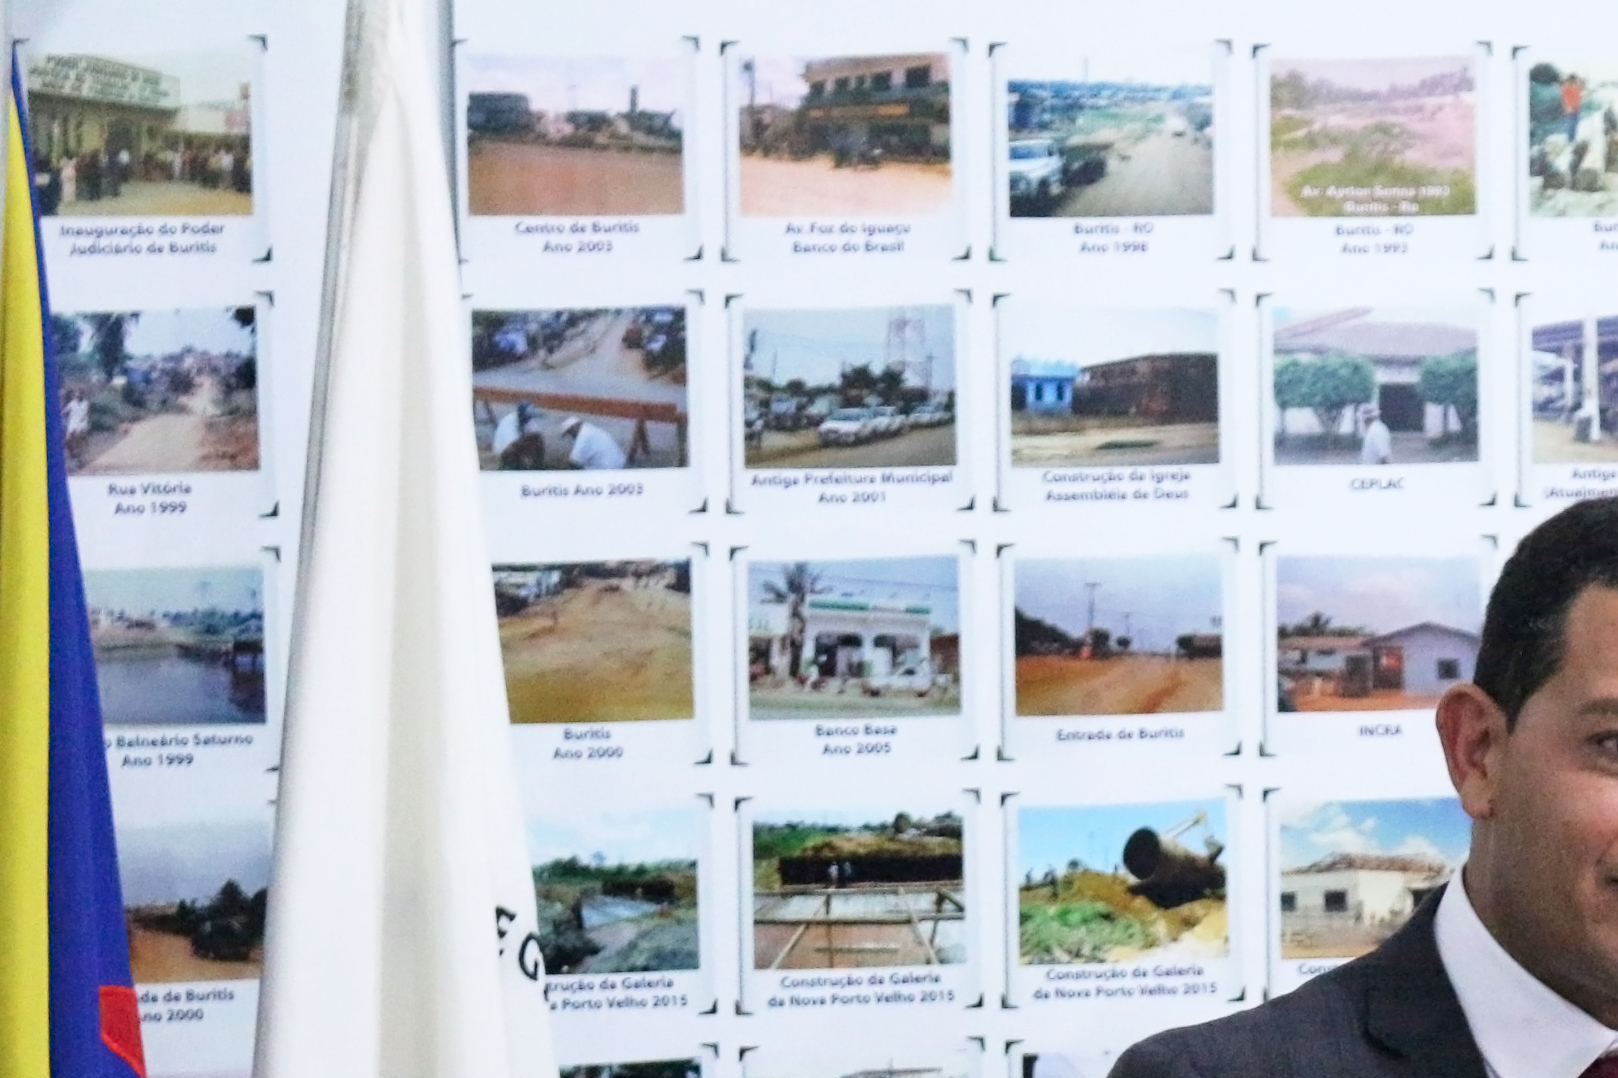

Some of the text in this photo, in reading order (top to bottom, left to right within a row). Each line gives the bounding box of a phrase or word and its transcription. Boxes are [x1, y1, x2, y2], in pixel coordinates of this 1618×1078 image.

[60, 221, 223, 239] Inauguração do Poder
[515, 218, 638, 234] Centro de Buritis
[786, 220, 910, 236] Av. Foz do Iguaçu
[71, 240, 216, 255] Judiciário de Buritis
[544, 238, 572, 252] Ano
[793, 238, 903, 252] Banco do Brasil
[805, 470, 875, 486] Prefeitura
[881, 469, 952, 486] Municipal
[109, 480, 191, 495] Rua Vitória
[522, 482, 568, 497] Buritis
[574, 482, 602, 496] Ano
[819, 489, 846, 503] Ano
[115, 500, 144, 514] Ano
[564, 726, 610, 740] Buritis
[816, 722, 858, 736] Banco
[116, 730, 252, 747] Balneário Saturno
[554, 745, 582, 760] Ano
[823, 741, 850, 755] Ano
[122, 751, 151, 766] Ano
[600, 974, 672, 990] da Galeria
[781, 970, 940, 990] Construção da Galeria
[163, 989, 180, 1003] de
[186, 988, 234, 1003] Buritis
[562, 995, 602, 1010] Porto
[607, 993, 647, 1009] Velho
[768, 993, 785, 1007] da
[790, 991, 826, 1006] Nova
[831, 990, 870, 1005] Porto
[876, 989, 914, 1004] Velho
